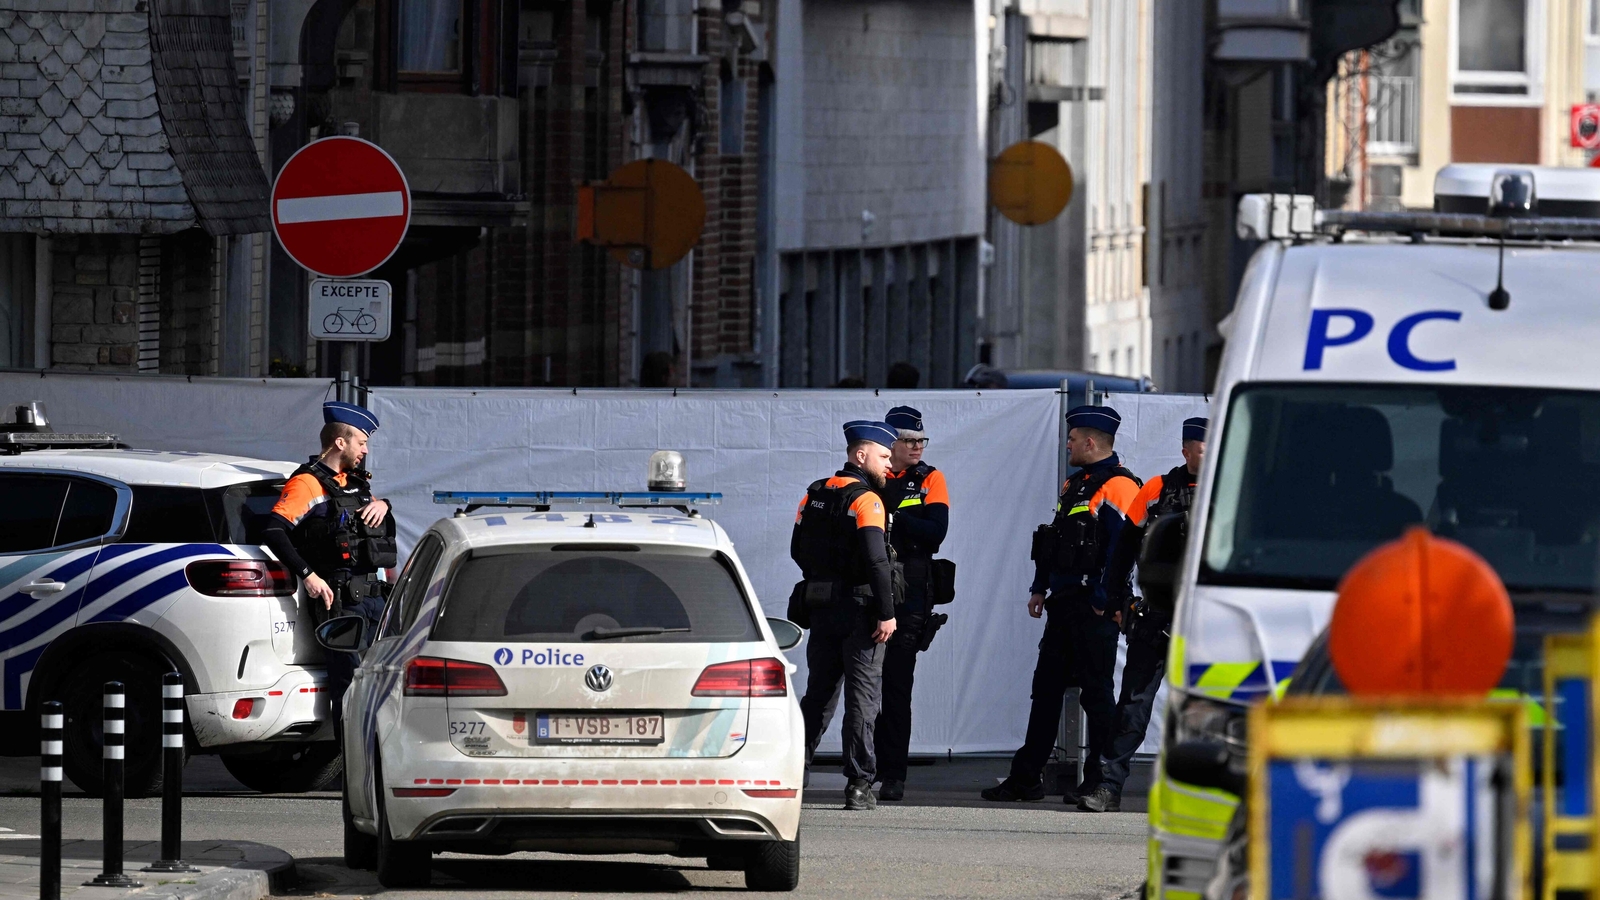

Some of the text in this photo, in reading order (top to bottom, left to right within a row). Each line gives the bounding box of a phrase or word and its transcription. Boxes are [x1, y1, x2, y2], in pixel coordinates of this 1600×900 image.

[321, 285, 379, 298] EXCEPTE
[1303, 308, 1463, 372] PC
[810, 499, 825, 509] POLICE
[274, 620, 296, 634] 5277
[521, 648, 584, 666] Police
[450, 721, 486, 735] 5277
[540, 728, 548, 736] B
